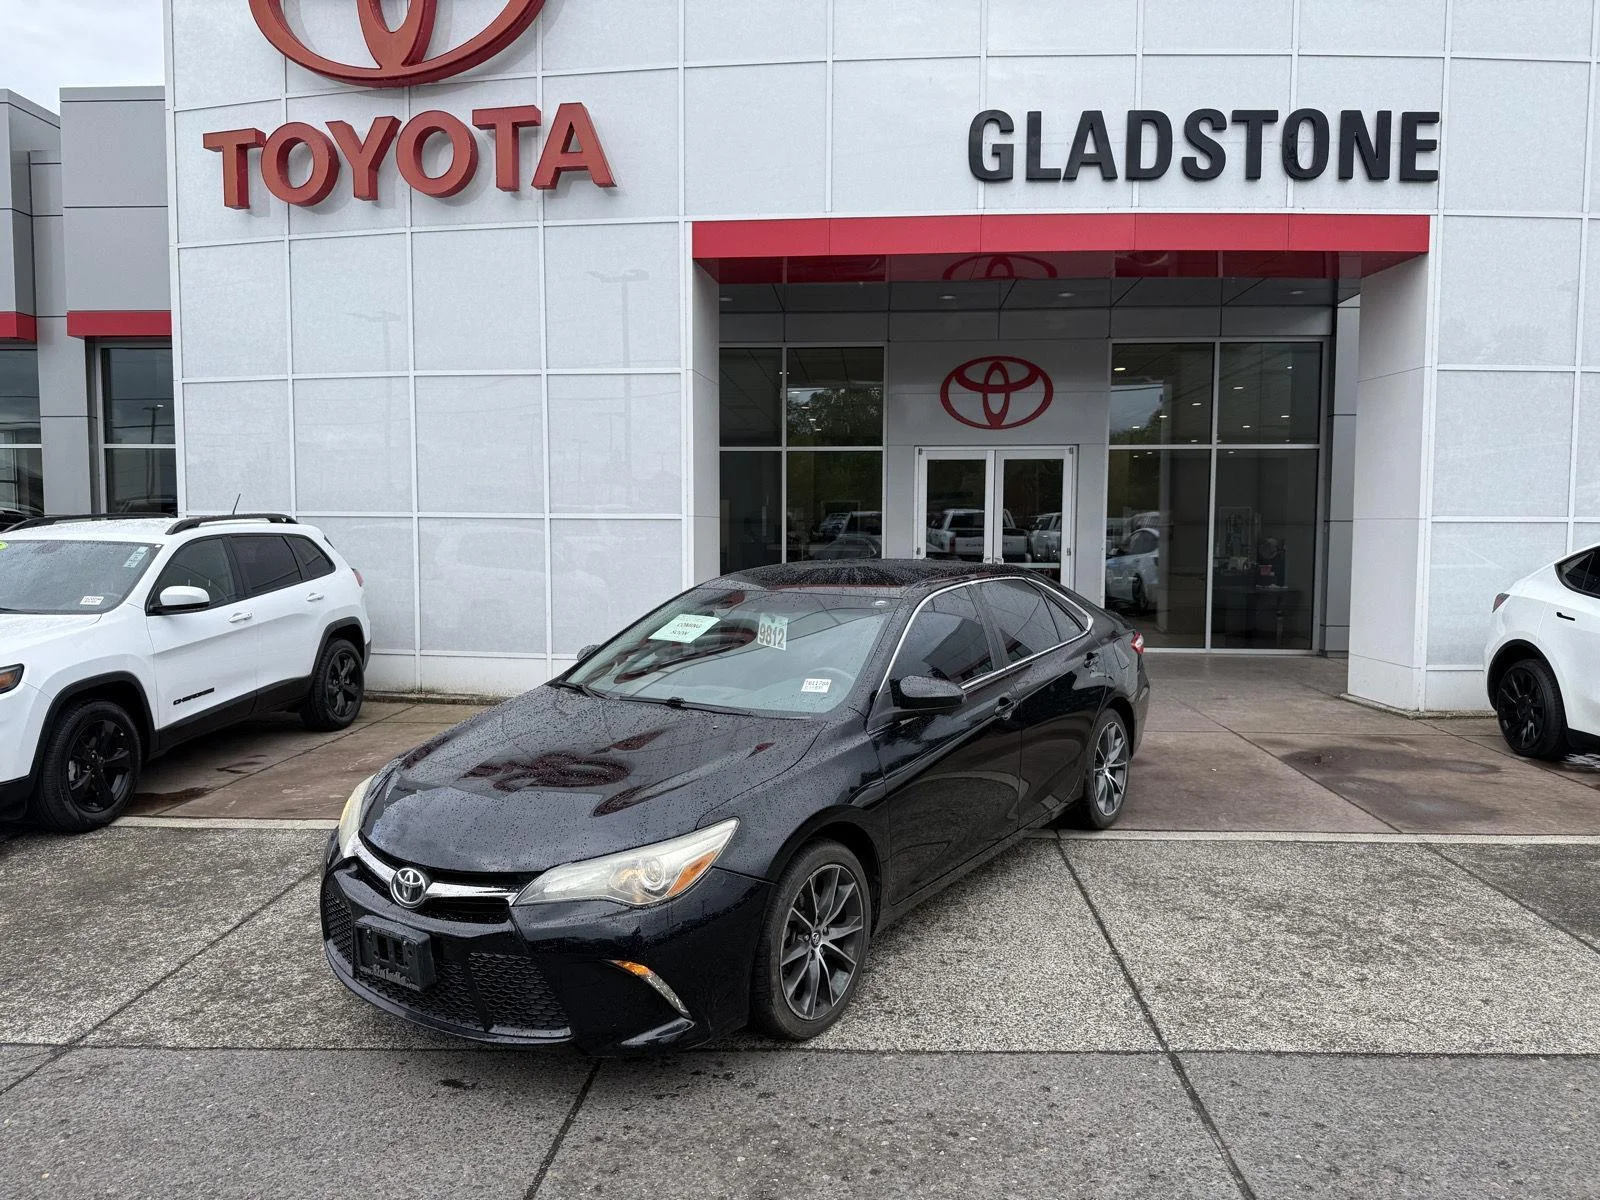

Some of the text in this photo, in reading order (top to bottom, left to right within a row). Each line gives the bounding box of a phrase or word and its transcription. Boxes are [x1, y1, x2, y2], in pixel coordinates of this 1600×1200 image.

[203, 102, 616, 210] TOYOTA
[968, 108, 1440, 181] GLADSTONE
[760, 623, 785, 648] 9812
